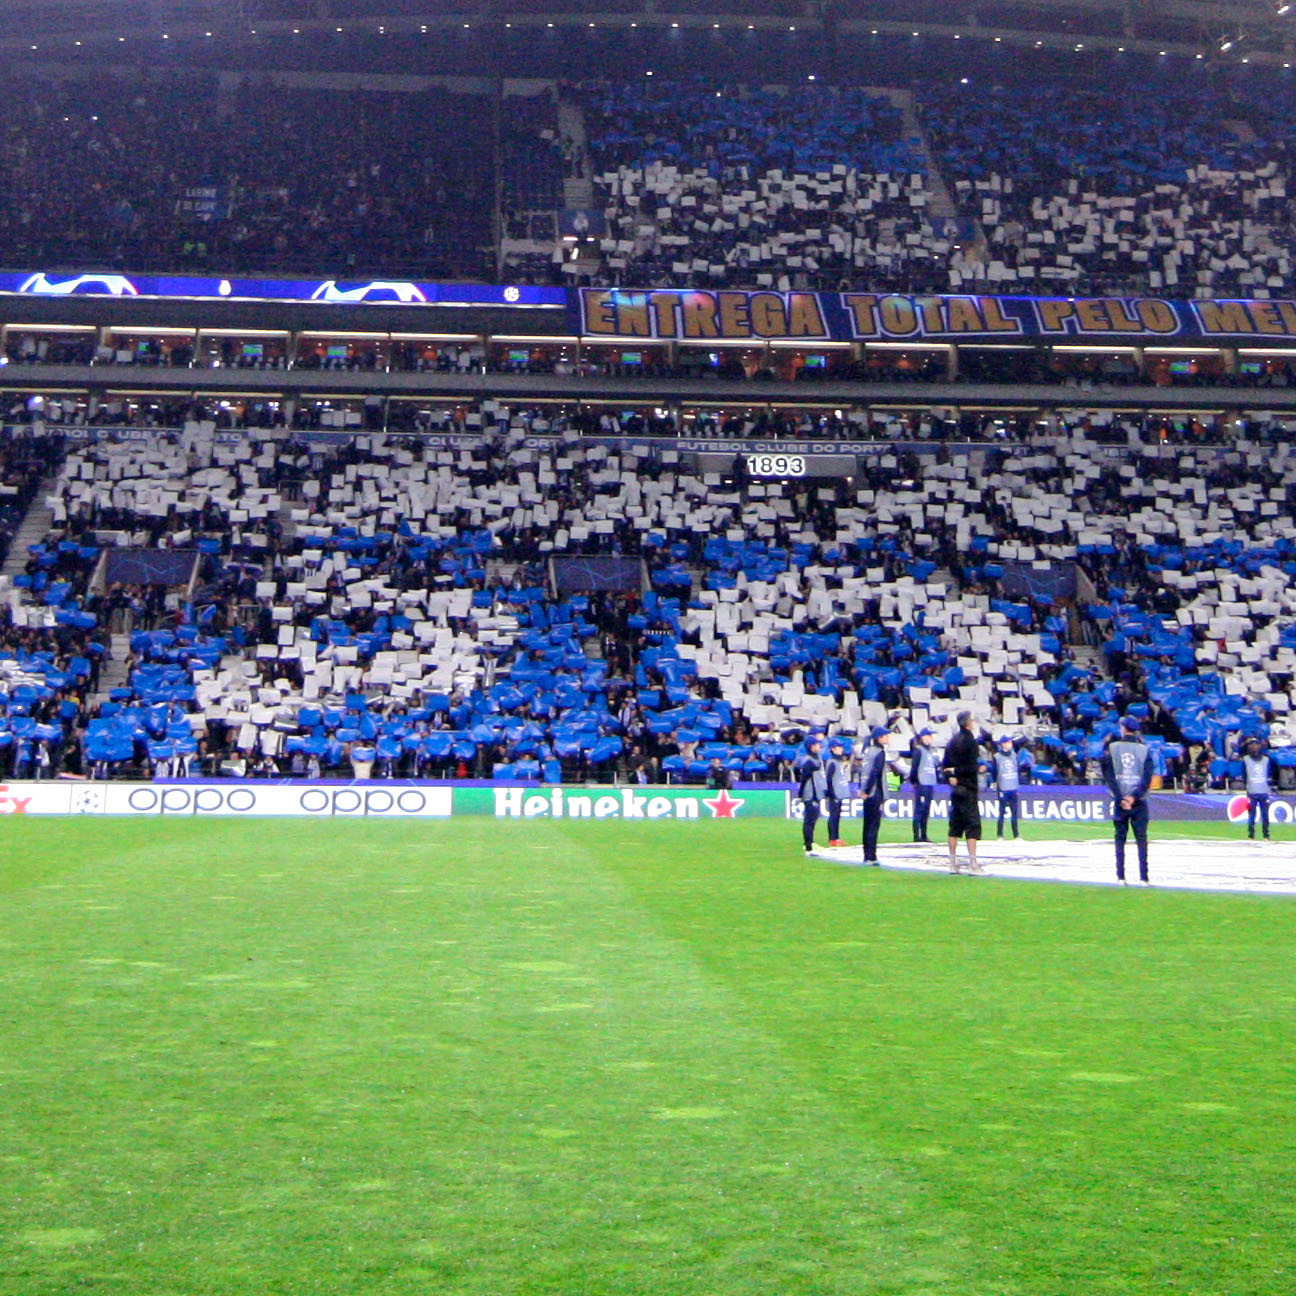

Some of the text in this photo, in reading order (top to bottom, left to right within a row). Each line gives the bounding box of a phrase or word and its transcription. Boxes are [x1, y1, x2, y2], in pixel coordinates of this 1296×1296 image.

[583, 290, 826, 337] ENTREGA
[844, 294, 1020, 334] TOTAL
[1039, 299, 1179, 334] PELO
[677, 441, 751, 452] FUTEBOL
[755, 442, 808, 453] CLUBE
[812, 443, 836, 453] DO
[748, 455, 806, 476] 1893
[128, 787, 257, 815] oppo
[299, 788, 427, 816] oppo
[492, 787, 699, 818] Heineken
[820, 798, 882, 817] UEF
[1020, 799, 1104, 819] LEAGUE
